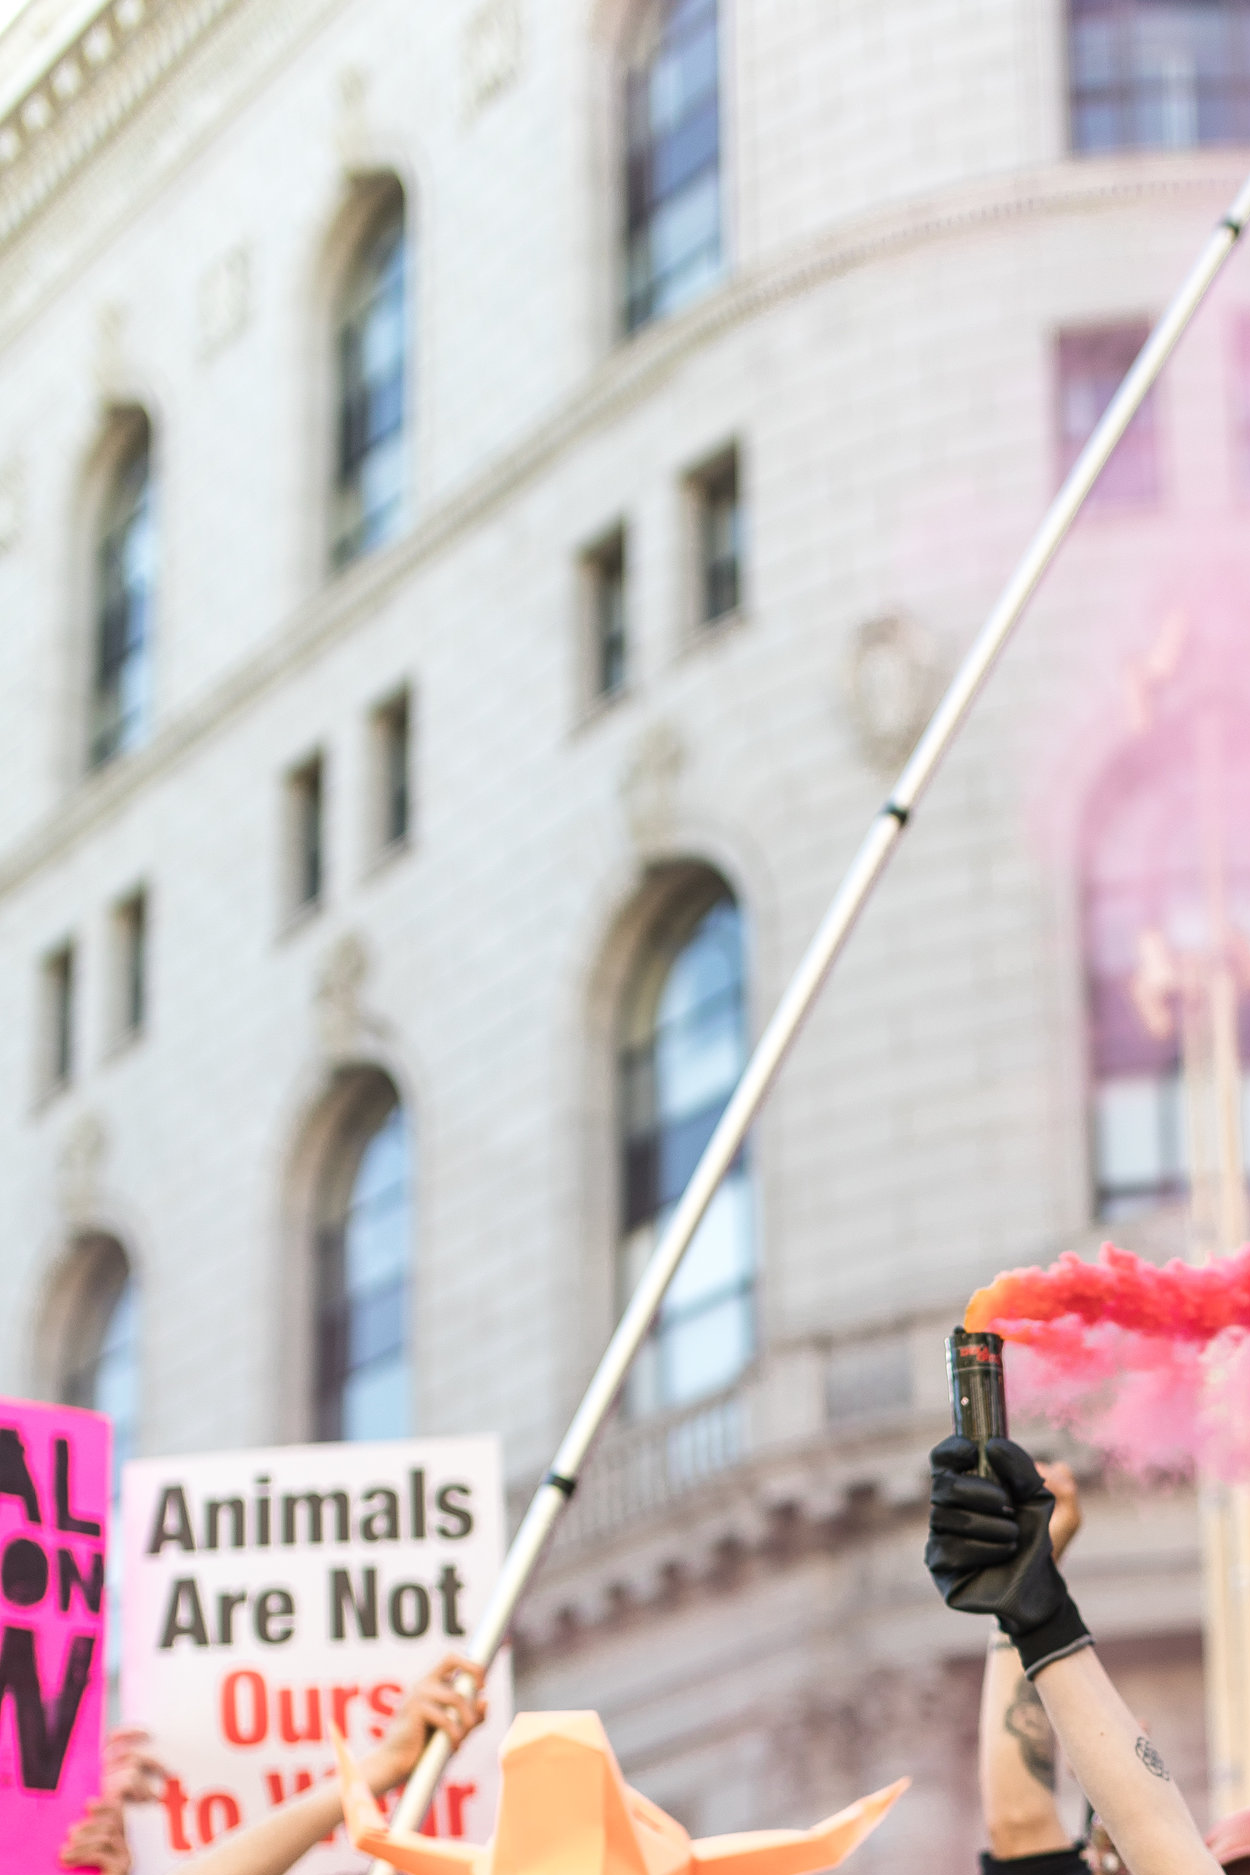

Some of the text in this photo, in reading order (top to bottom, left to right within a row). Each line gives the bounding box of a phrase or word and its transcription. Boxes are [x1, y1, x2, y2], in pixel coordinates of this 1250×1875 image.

[147, 1469, 474, 1556] Animals
[159, 1565, 466, 1648] Are Not
[220, 1669, 404, 1748] Ours
[162, 1777, 241, 1851] to
